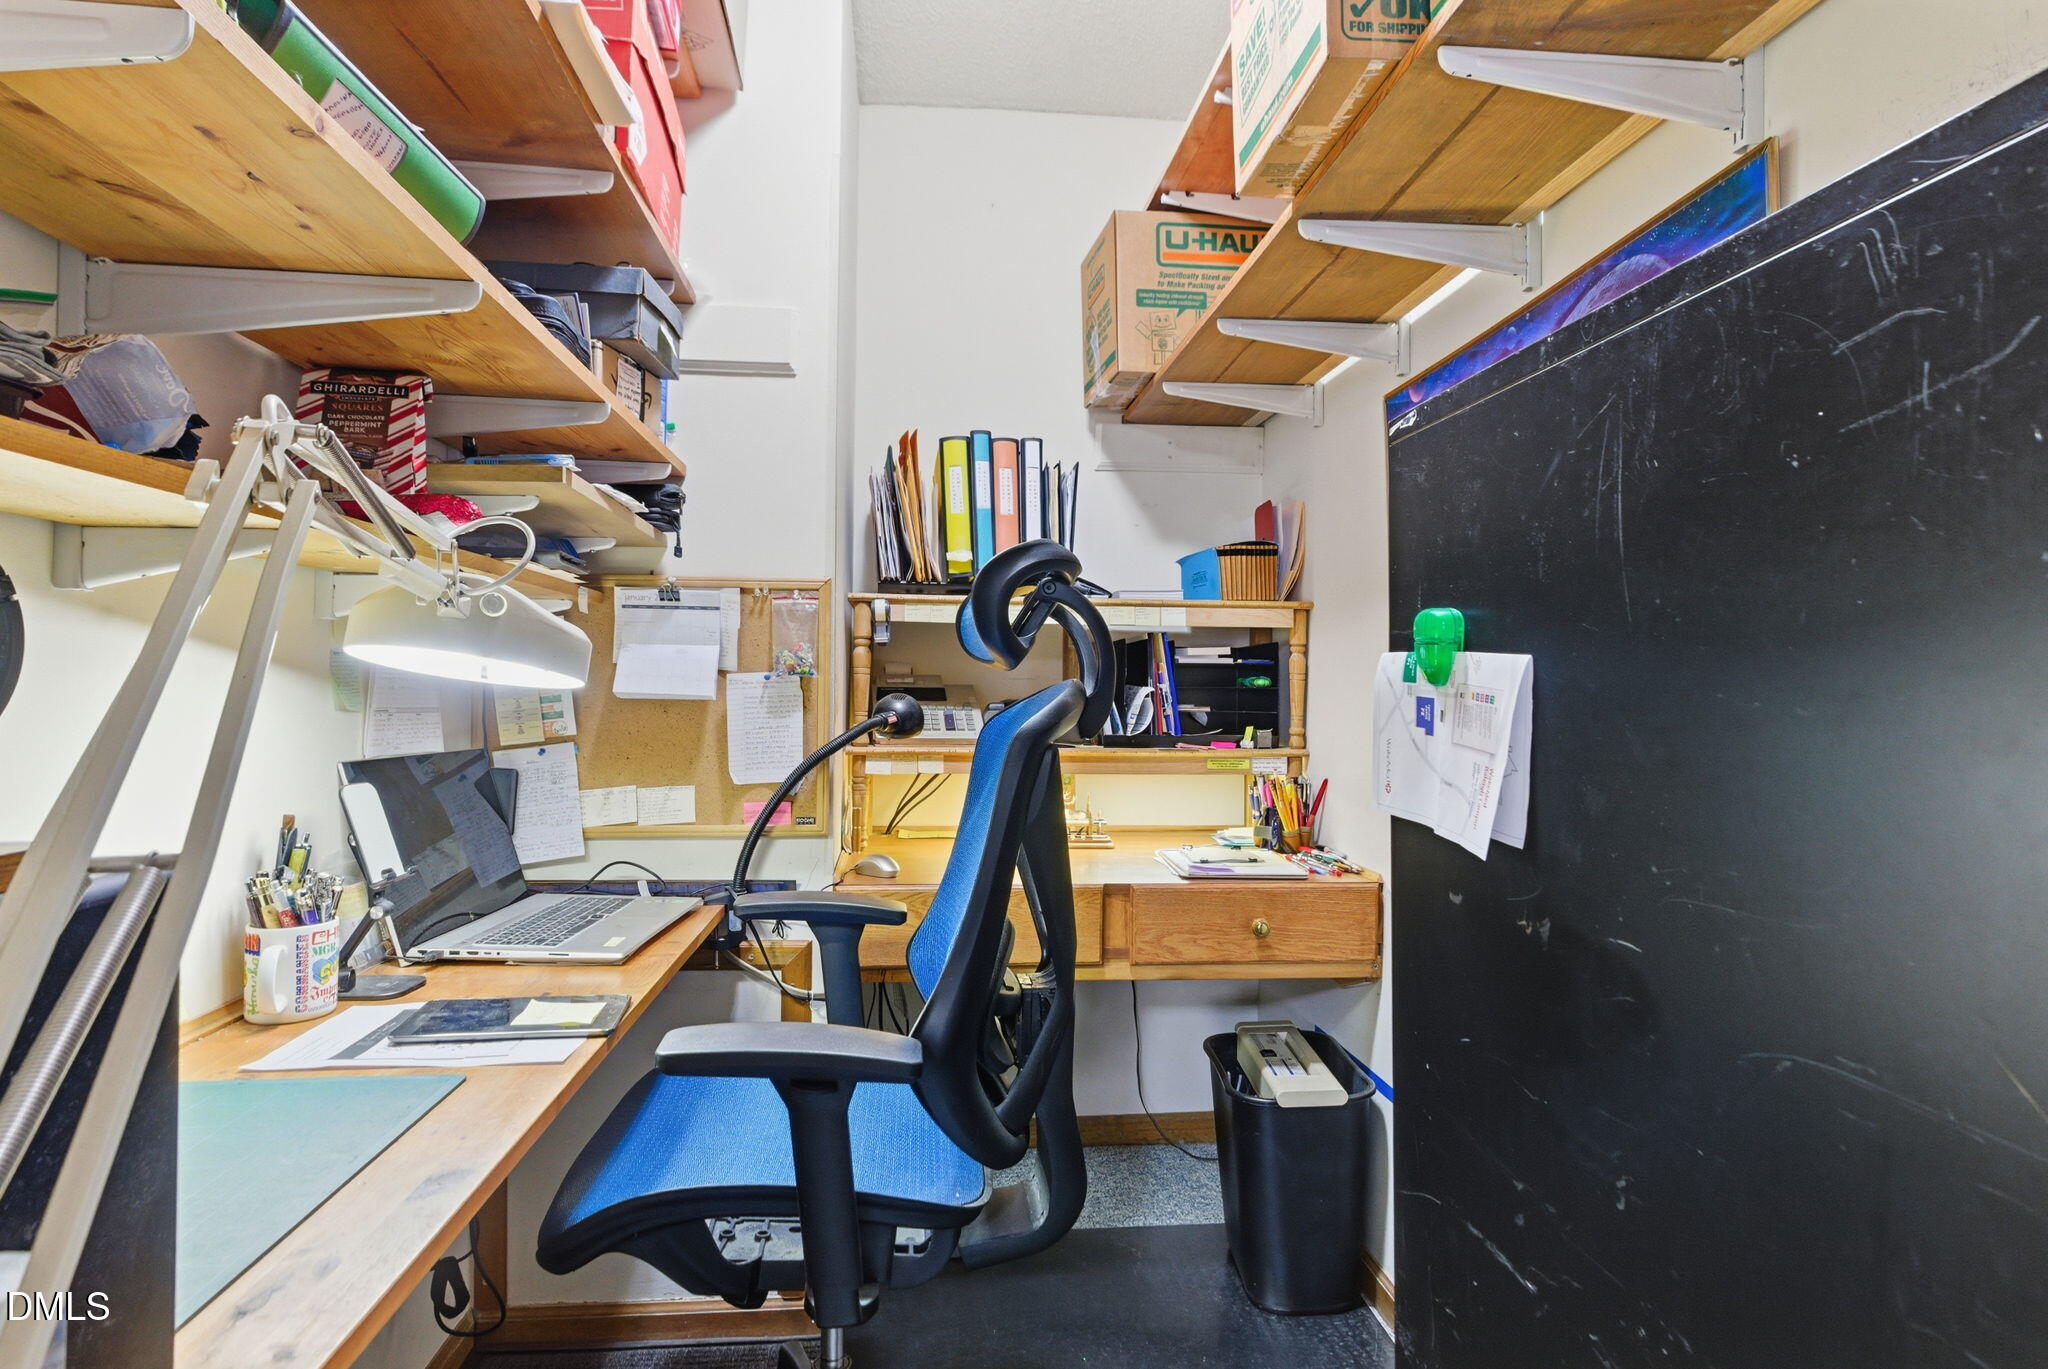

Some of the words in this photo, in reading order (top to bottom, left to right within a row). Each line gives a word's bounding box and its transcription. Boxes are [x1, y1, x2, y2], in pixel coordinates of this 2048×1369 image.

[1350, 21, 1373, 32] FOR
[1165, 230, 1264, 253] U-HAU
[1158, 271, 1200, 281] Specifically
[1201, 273, 1220, 281] Sized
[1188, 282, 1215, 290] Packing
[313, 383, 405, 396] GHIRARDELLI
[331, 402, 384, 412] SQUARES
